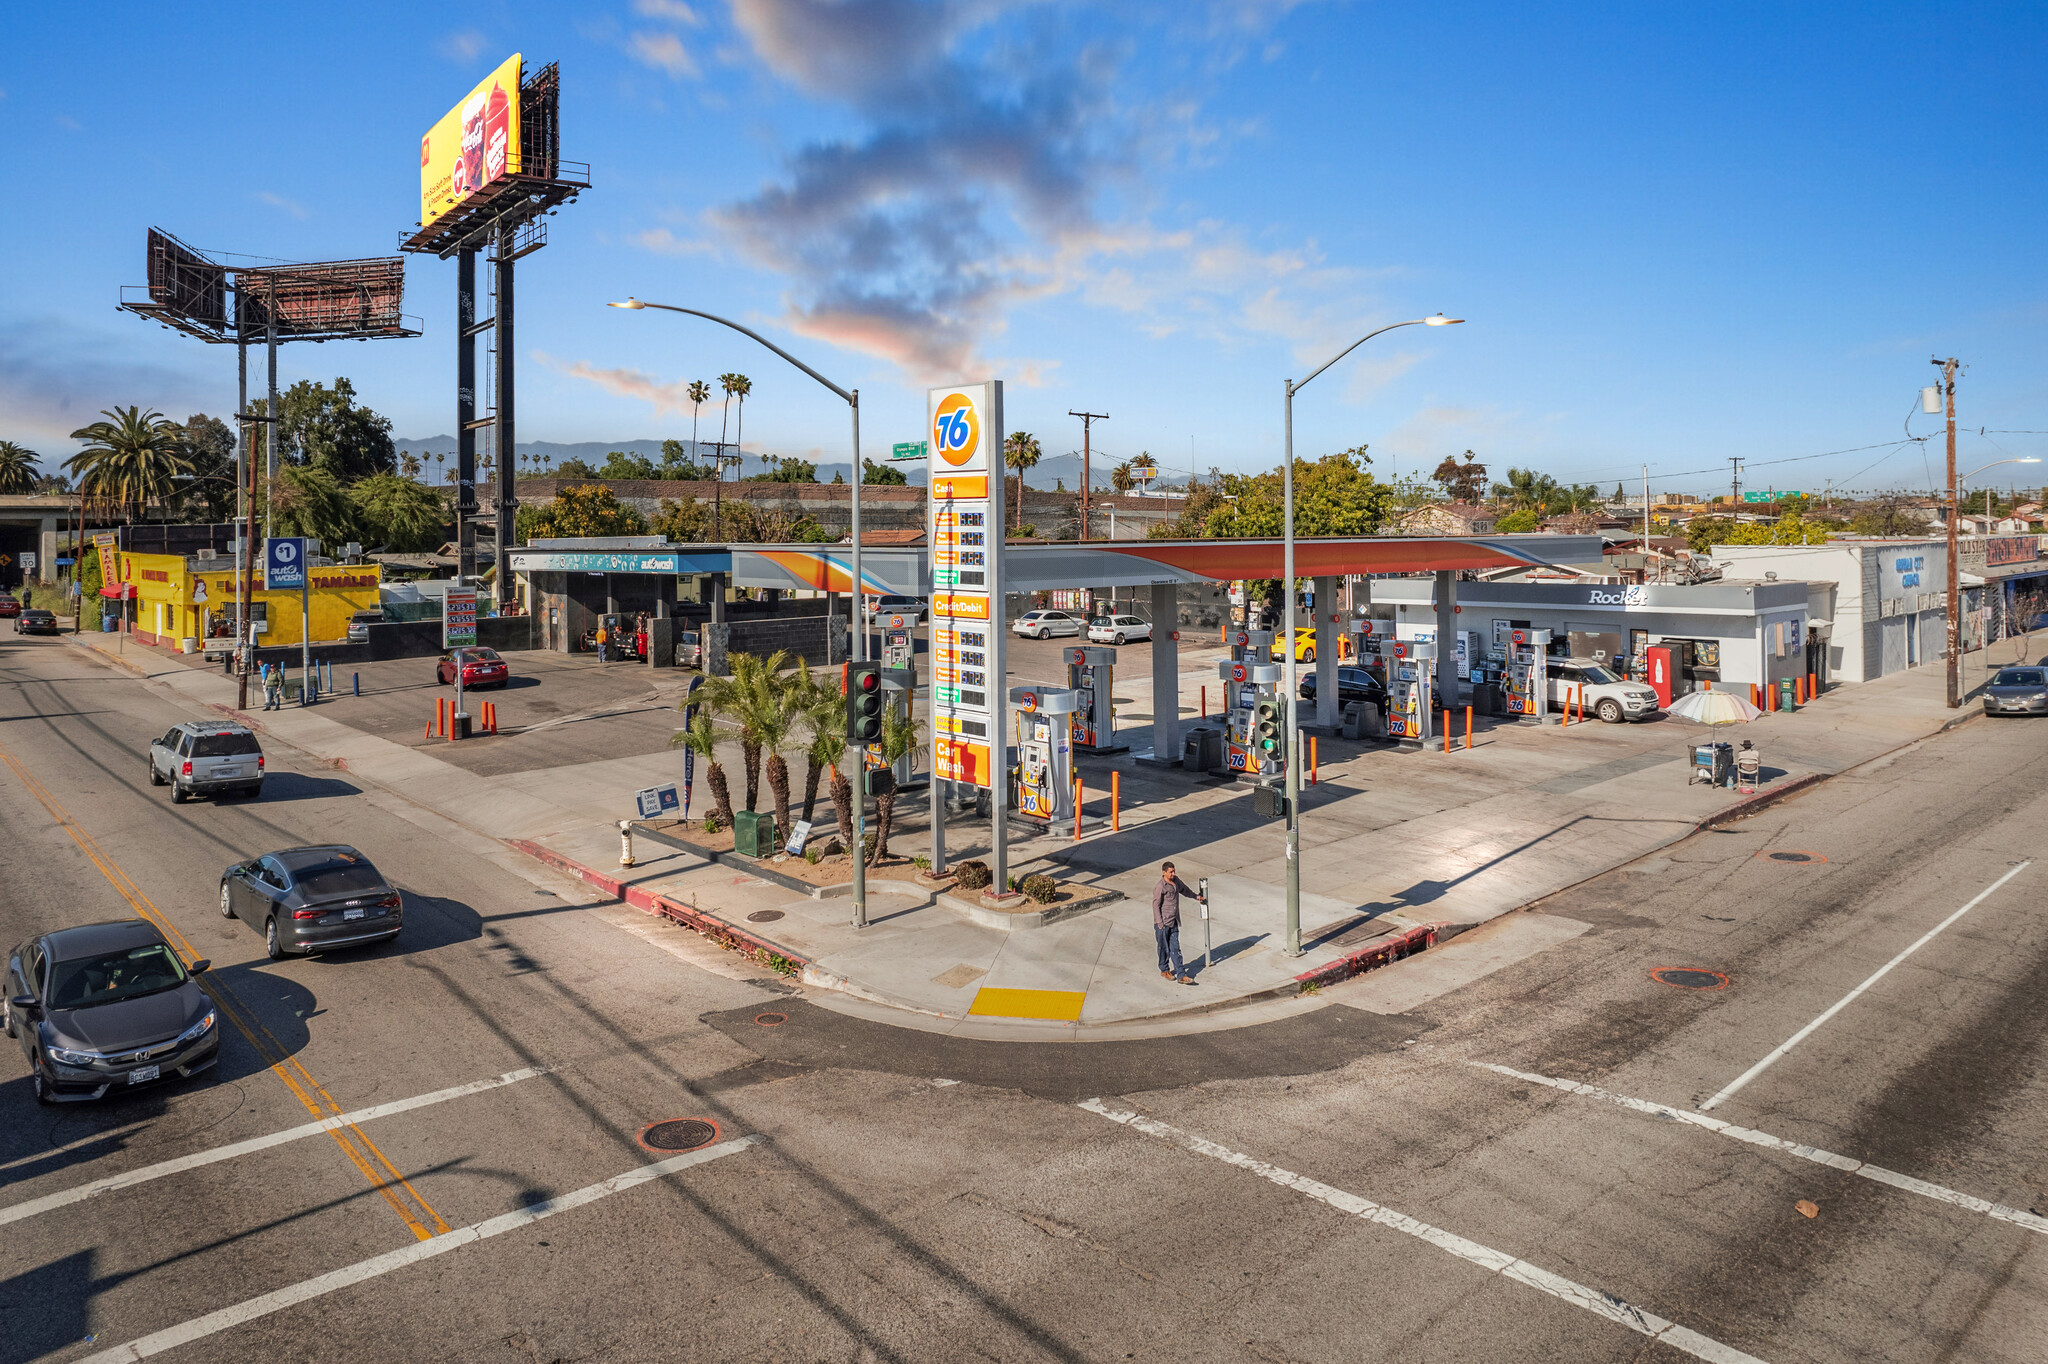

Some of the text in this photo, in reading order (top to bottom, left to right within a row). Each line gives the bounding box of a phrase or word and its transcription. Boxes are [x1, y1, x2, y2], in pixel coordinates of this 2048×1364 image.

[936, 406, 972, 451] 76
[935, 483, 953, 493] Cash
[278, 546, 291, 558] $1
[270, 564, 297, 575] auto
[274, 573, 302, 582] wash
[312, 575, 377, 589] TAMALES
[1588, 589, 1648, 606] Rocket
[936, 600, 983, 614] Credit/Debit
[1513, 633, 1522, 641] 76
[1074, 653, 1082, 661] 76
[1394, 647, 1404, 655] 76
[1232, 668, 1242, 678] 76
[1023, 697, 1032, 707] 76
[1510, 700, 1524, 711] 76
[1391, 721, 1405, 733] 76
[1073, 729, 1085, 741] 76
[937, 742, 955, 757] Car
[937, 757, 965, 775] Wash
[1230, 753, 1246, 768] 76
[1022, 793, 1037, 812] 76
